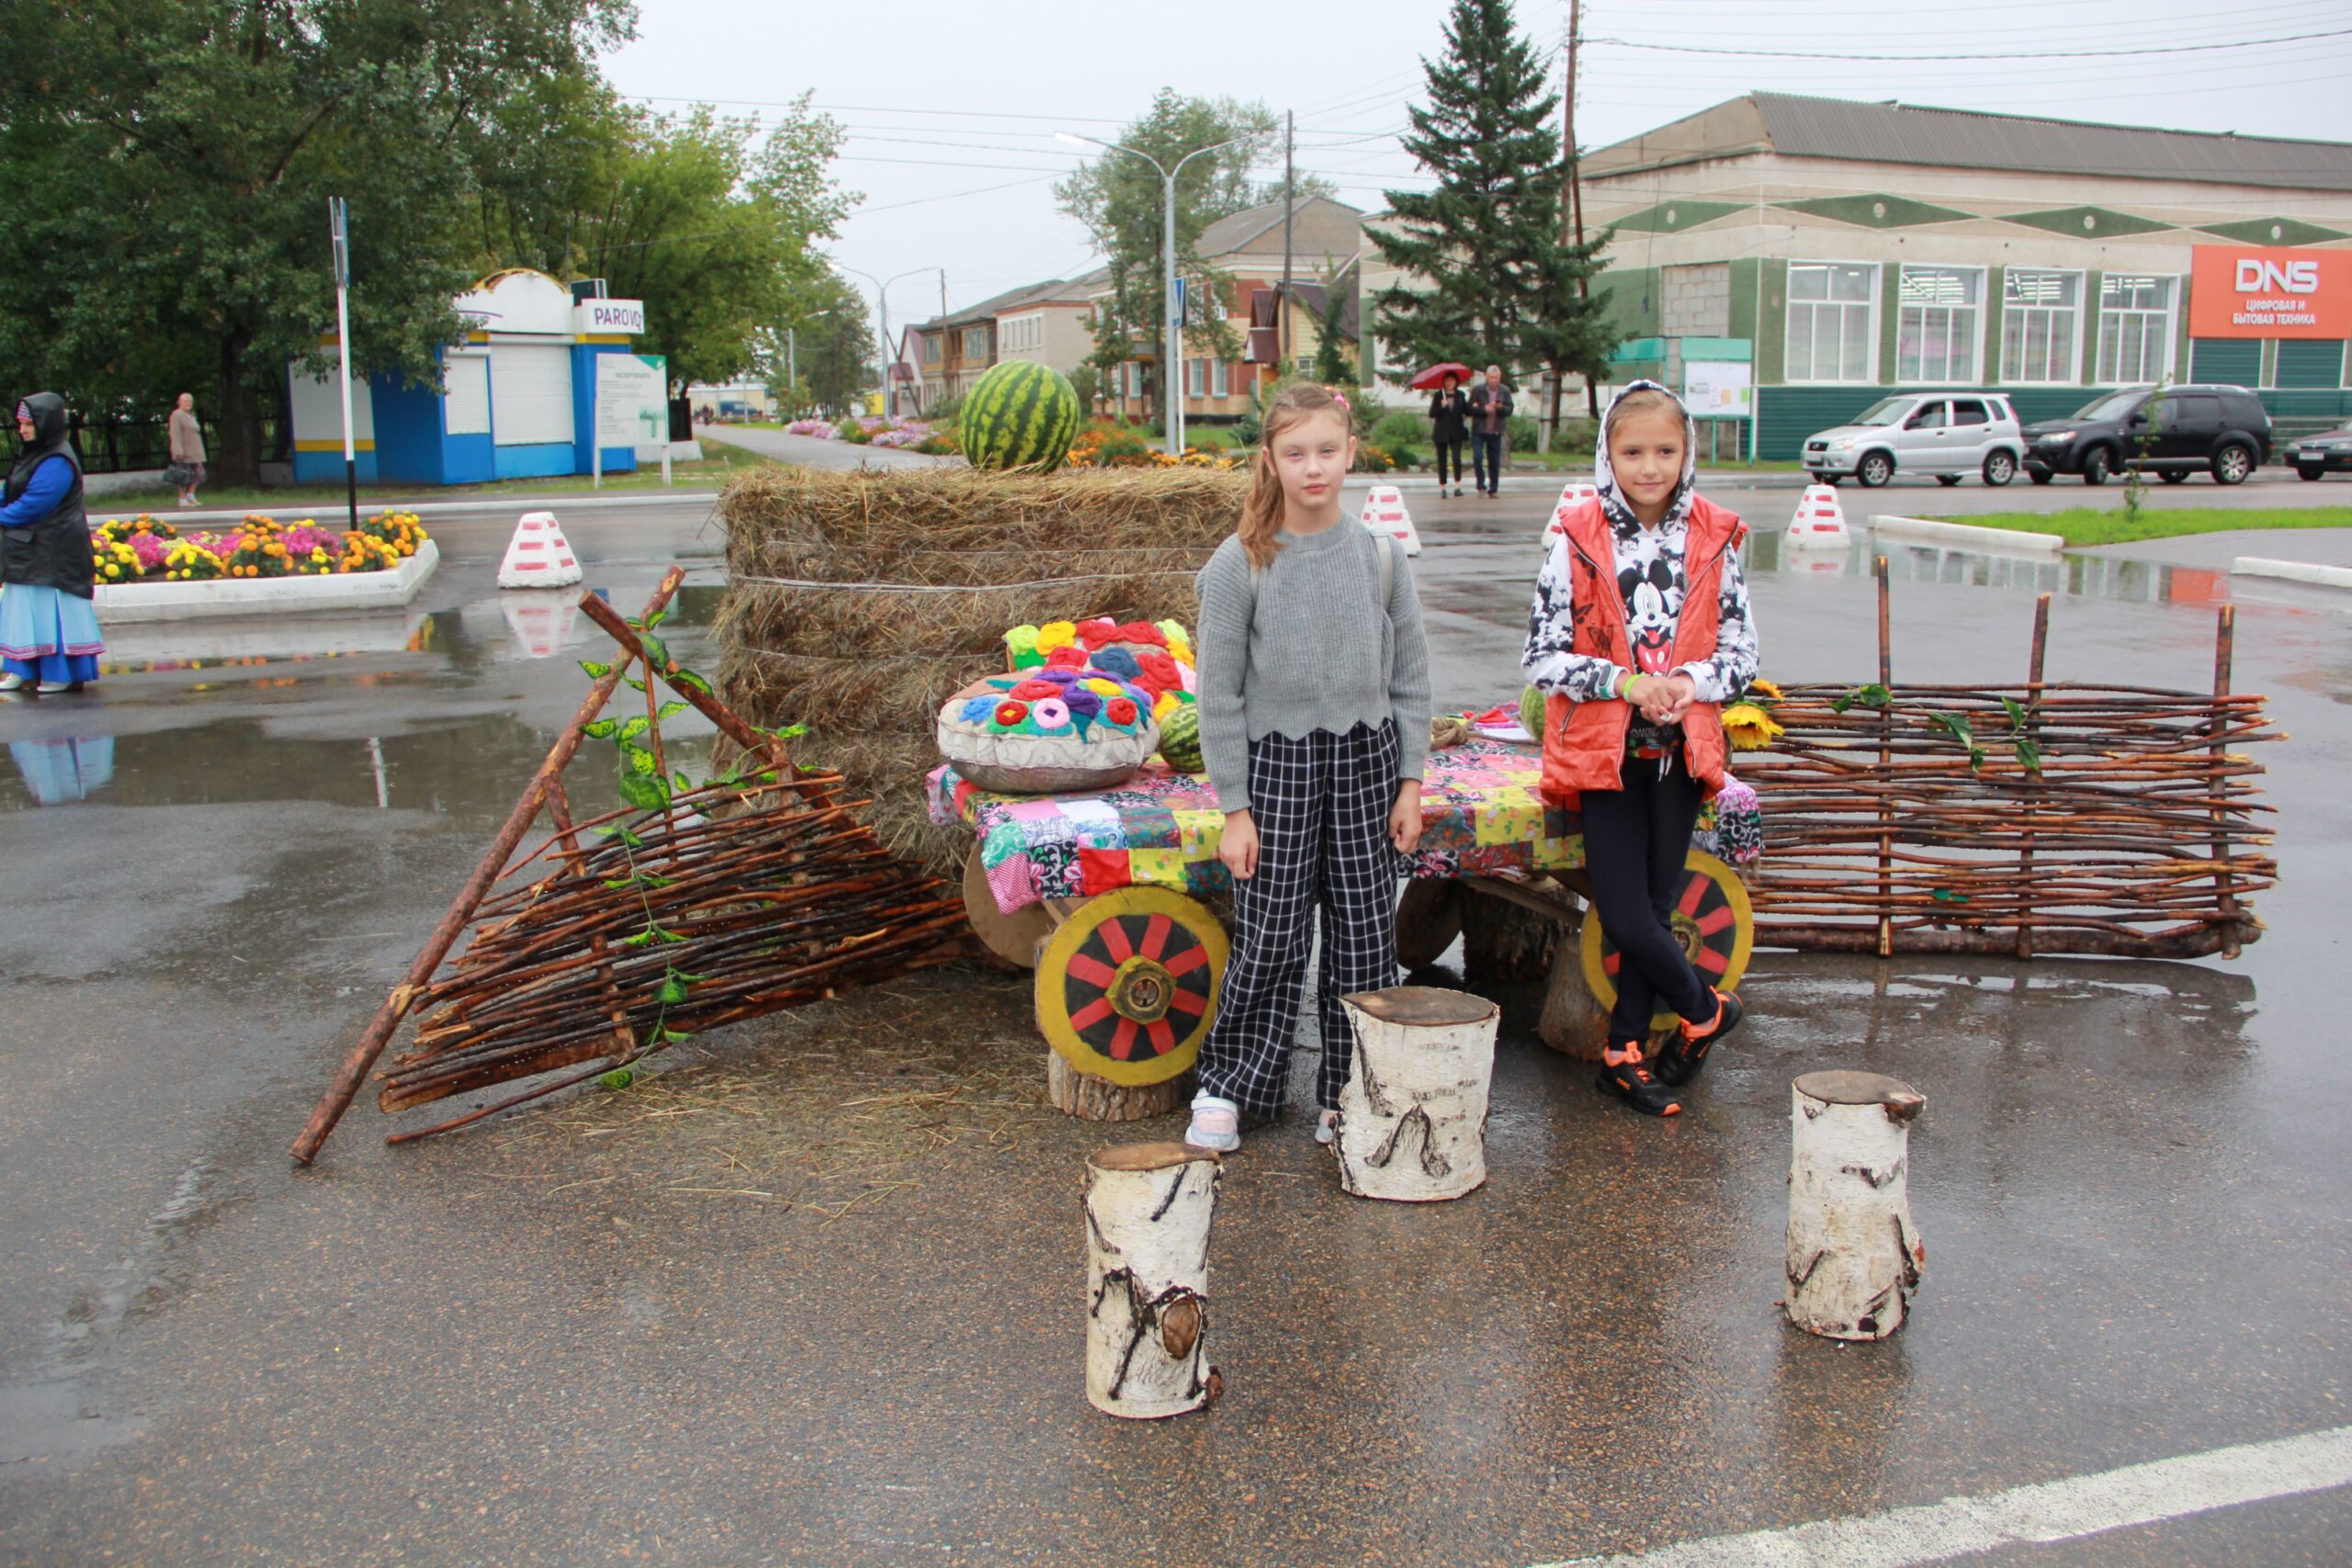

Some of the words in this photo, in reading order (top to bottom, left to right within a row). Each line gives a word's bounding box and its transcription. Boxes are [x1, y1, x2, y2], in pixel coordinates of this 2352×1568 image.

[2234, 259, 2318, 293] DNS
[2245, 299, 2296, 311] ЦИФРОВАЯ
[2298, 300, 2305, 310] И
[2233, 312, 2274, 324] БЫТОВАЯ
[2277, 313, 2315, 324] ТЕХНИКА
